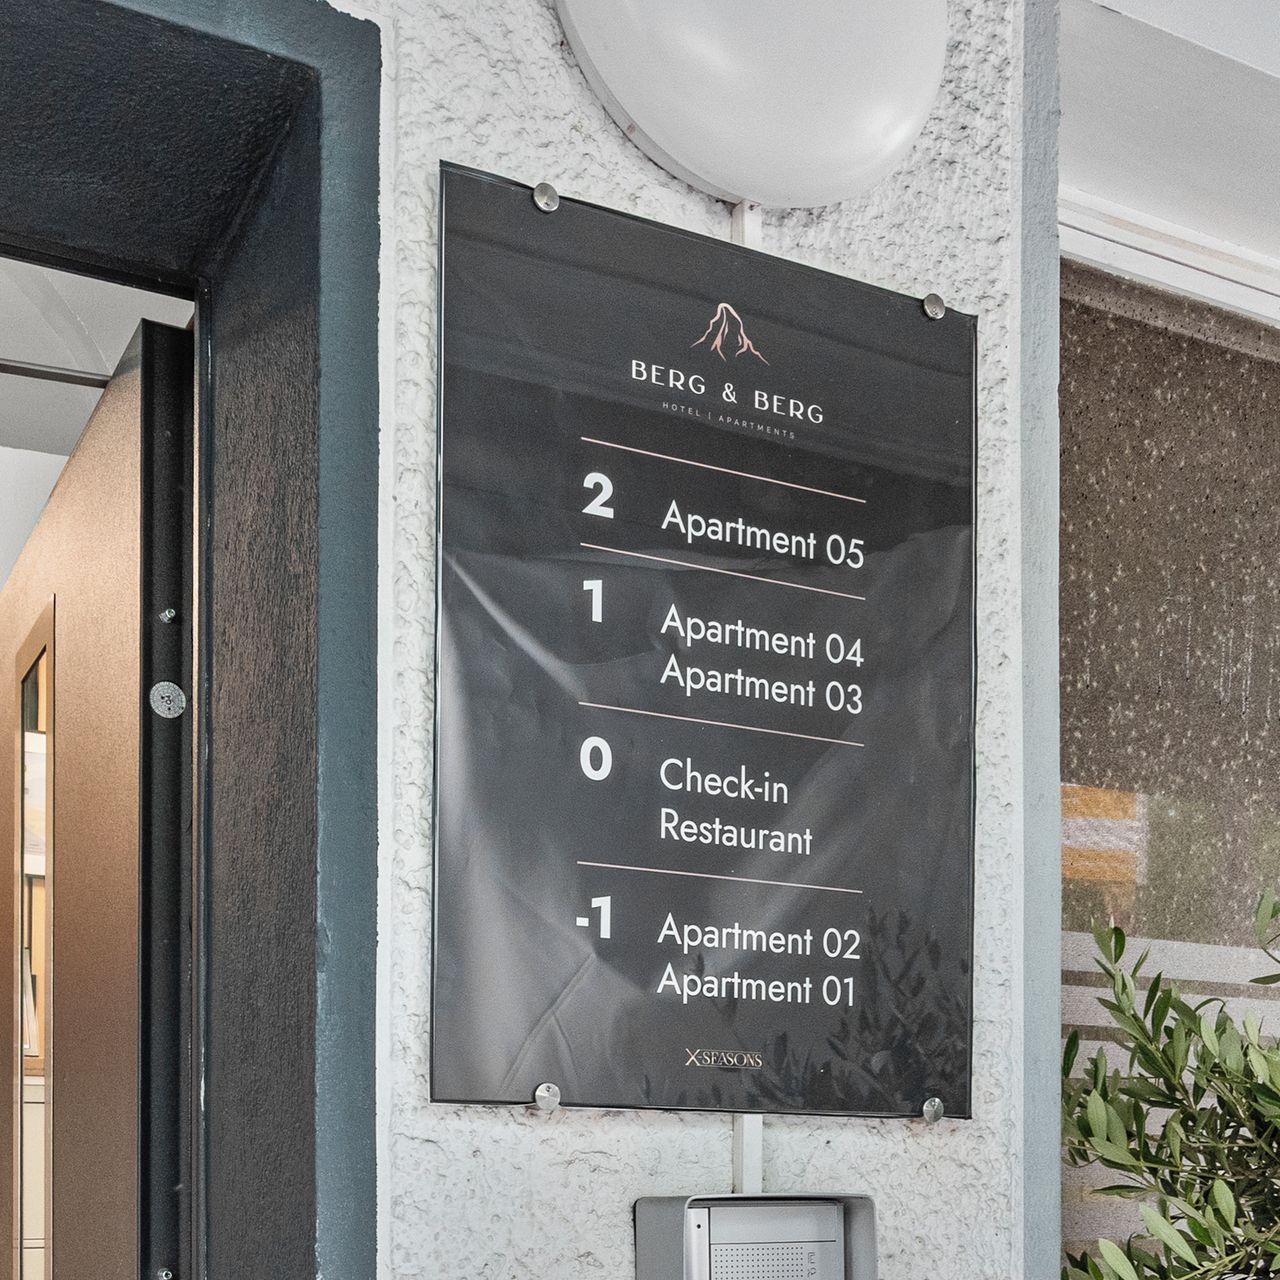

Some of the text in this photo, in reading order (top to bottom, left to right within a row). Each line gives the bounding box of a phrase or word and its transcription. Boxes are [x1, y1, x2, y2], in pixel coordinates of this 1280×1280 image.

[631, 359, 824, 424] BERG & BERG
[662, 401, 702, 418] HOTEL
[718, 415, 796, 440] APARTMENTS
[581, 471, 615, 520] 2
[661, 499, 865, 569] Apartment 05
[582, 579, 603, 623] 1
[660, 602, 865, 668] Apartment 04
[659, 652, 863, 715] Apartment 03
[579, 735, 613, 782] 0
[659, 757, 789, 804] Check-in
[659, 807, 814, 856] Restaurant
[575, 895, 612, 940] -1
[657, 911, 861, 961] Apartment 02
[656, 961, 855, 1007] Apartment 01
[684, 1047, 764, 1069] X-SEASONS
